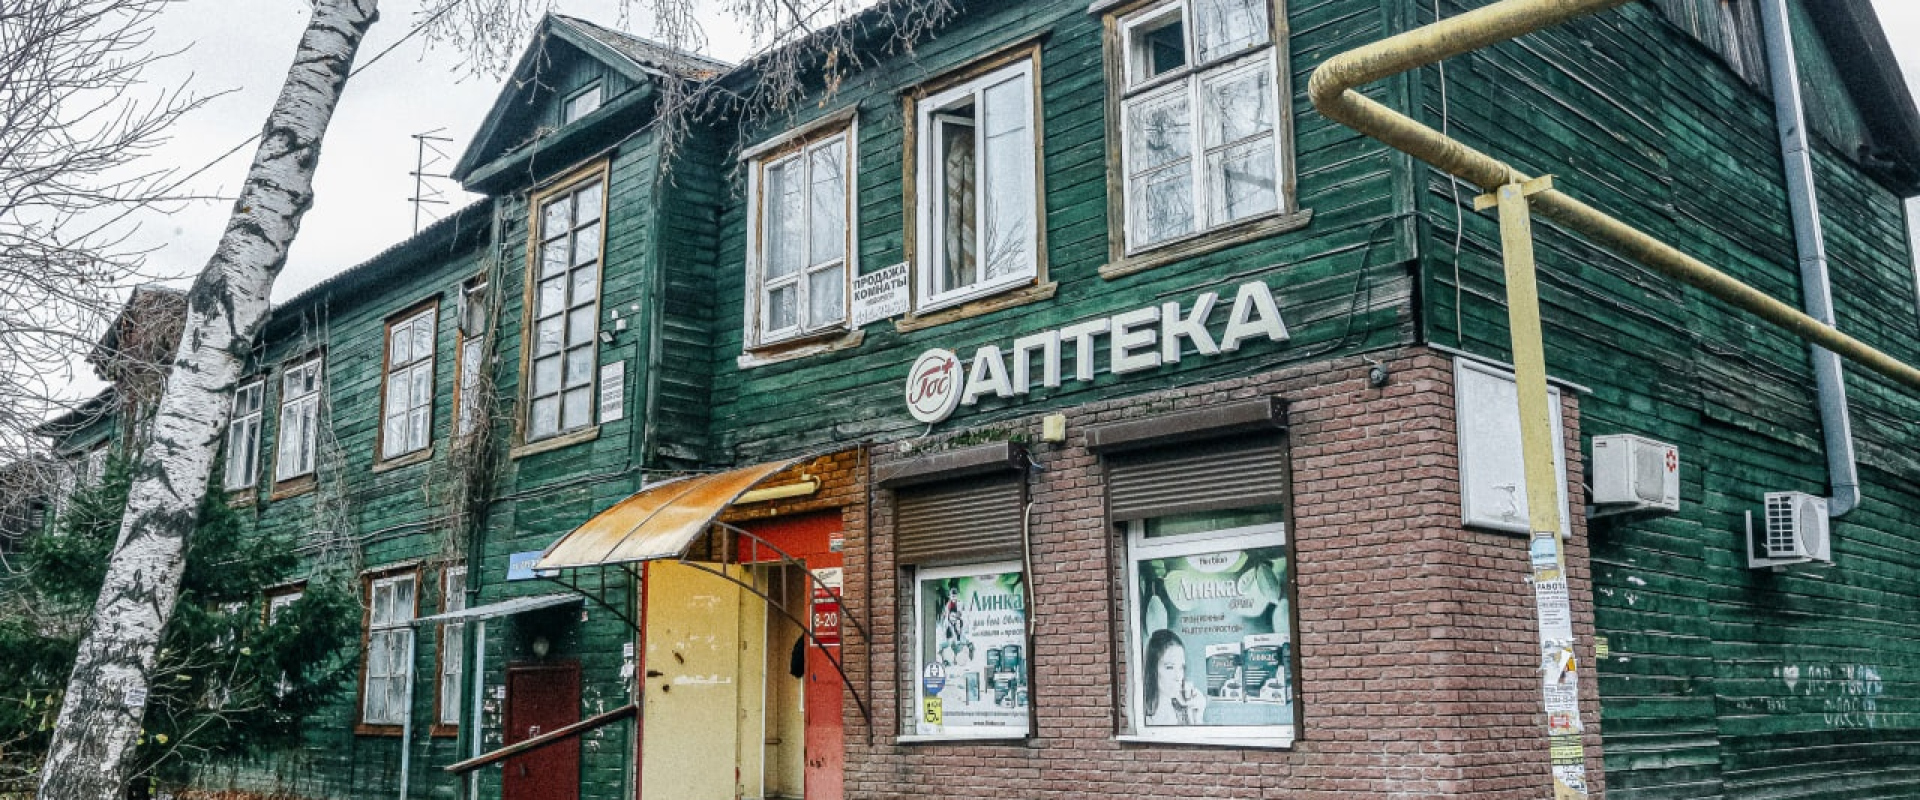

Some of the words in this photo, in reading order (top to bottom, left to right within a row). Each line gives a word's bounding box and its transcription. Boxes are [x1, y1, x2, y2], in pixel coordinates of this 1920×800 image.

[854, 265, 907, 289] ПРОДАЖА
[854, 276, 907, 300] КОМНАТЫ
[961, 281, 1290, 406] АПТЕКА
[814, 612, 838, 628] 8-20
